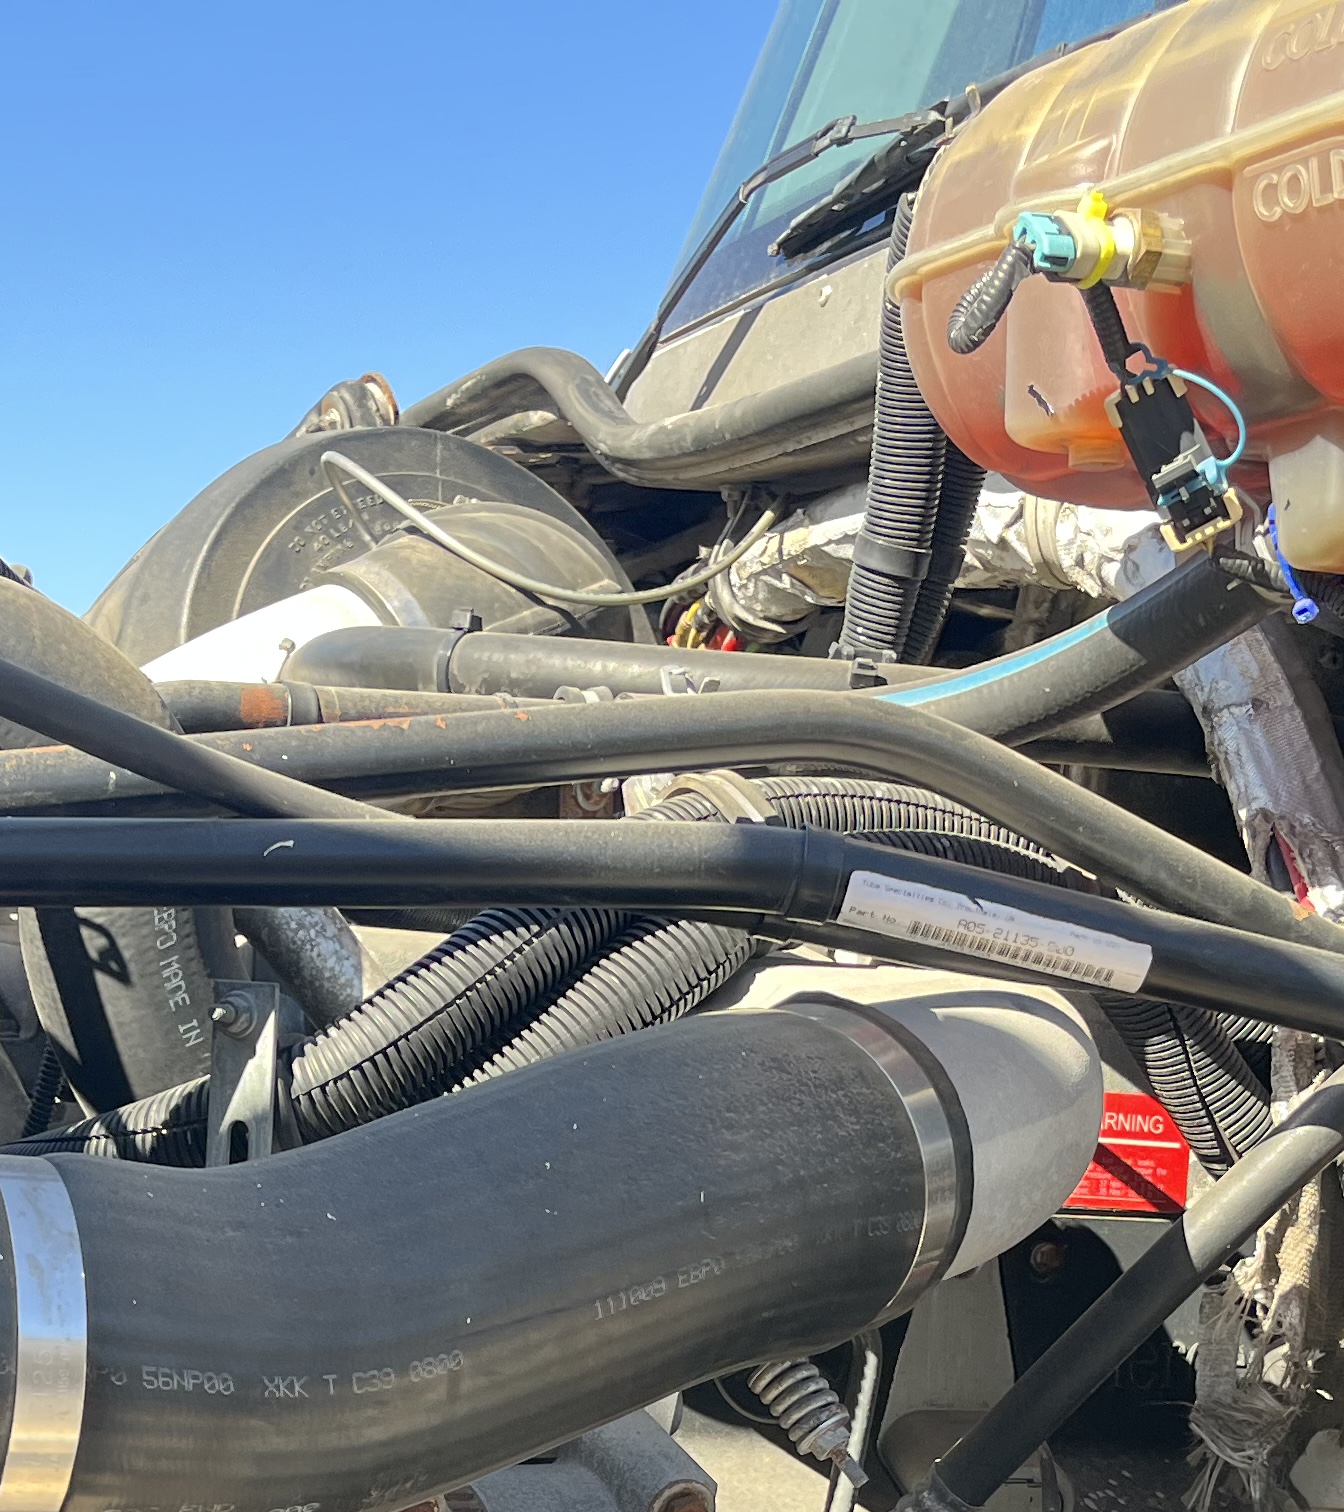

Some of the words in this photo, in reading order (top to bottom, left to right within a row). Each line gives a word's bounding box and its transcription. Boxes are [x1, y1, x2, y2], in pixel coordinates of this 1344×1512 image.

[849, 905, 876, 918] Part
[177, 1018, 205, 1048] IN
[1101, 1112, 1165, 1134] RNING
[322, 1373, 338, 1396] T
